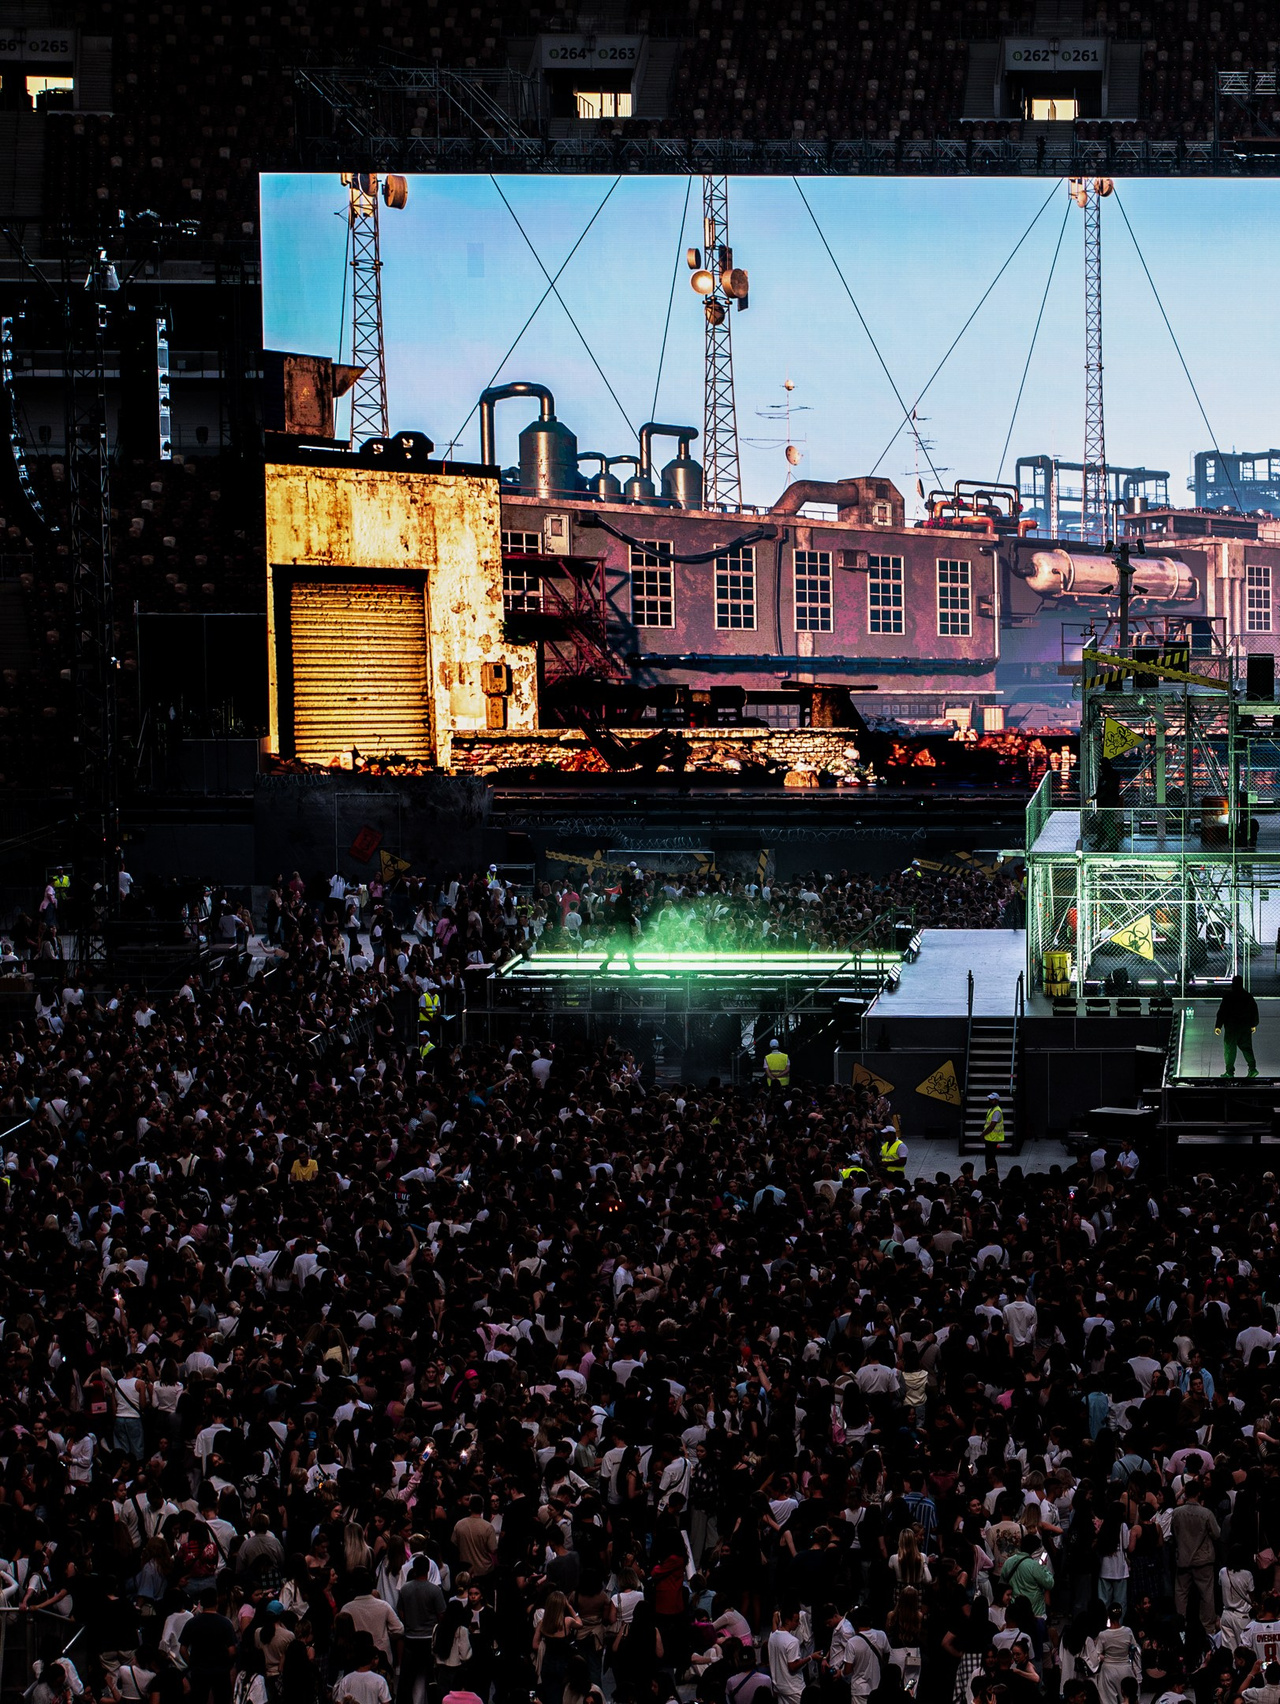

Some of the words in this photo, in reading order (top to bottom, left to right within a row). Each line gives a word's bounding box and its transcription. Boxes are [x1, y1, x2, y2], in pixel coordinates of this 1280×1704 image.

[41, 40, 69, 53] 265
[560, 47, 587, 60] 264
[609, 47, 636, 60] 263
[1023, 49, 1050, 62] 262
[1072, 49, 1098, 62] 261
[1264, 1643, 1277, 1662] 8
